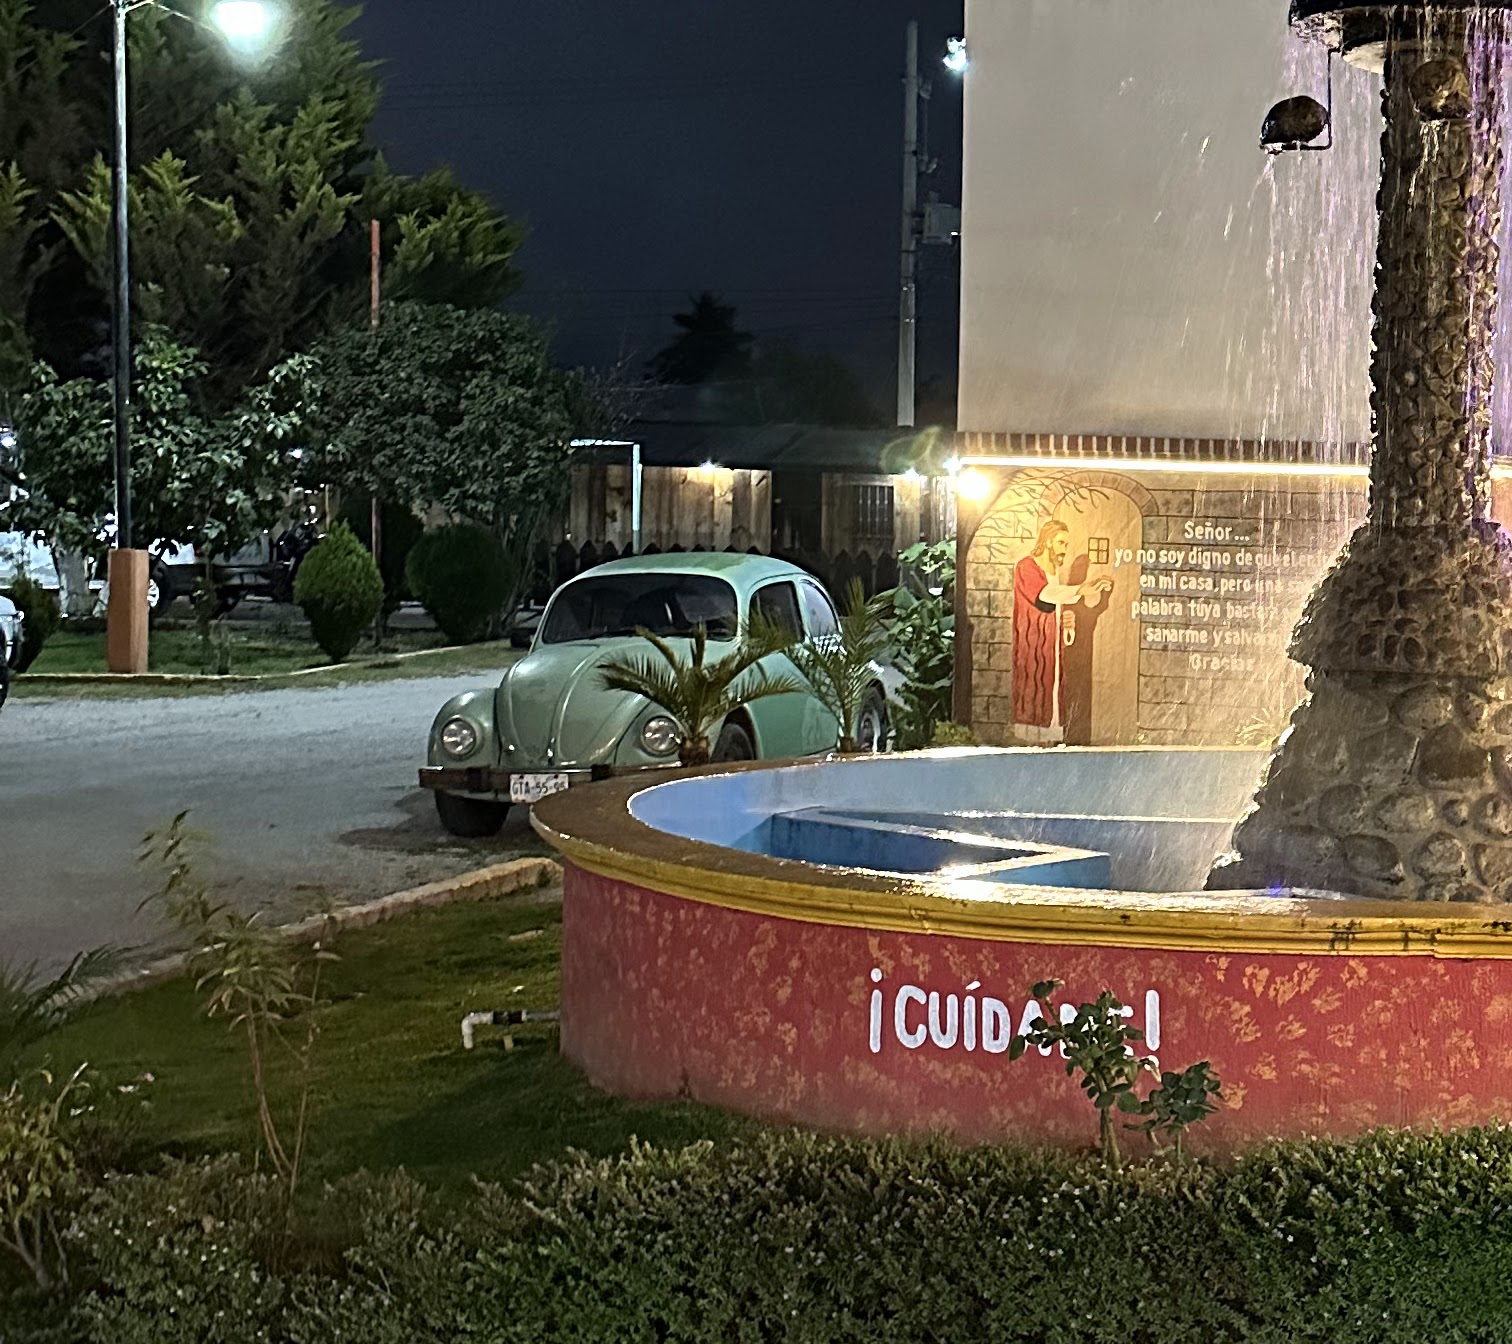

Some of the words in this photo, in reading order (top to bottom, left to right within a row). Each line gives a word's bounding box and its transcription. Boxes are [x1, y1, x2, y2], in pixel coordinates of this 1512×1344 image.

[1114, 548, 1133, 567] yo
[1136, 549, 1156, 564] no
[1159, 549, 1186, 567] soy
[1188, 547, 1231, 568] digno
[1235, 548, 1253, 565] de
[1140, 574, 1156, 588] en
[1159, 573, 1177, 589] mi
[1220, 580, 1251, 596] pero
[1131, 598, 1183, 619] palabra
[1146, 627, 1209, 644] sanarme
[1212, 629, 1224, 648] y
